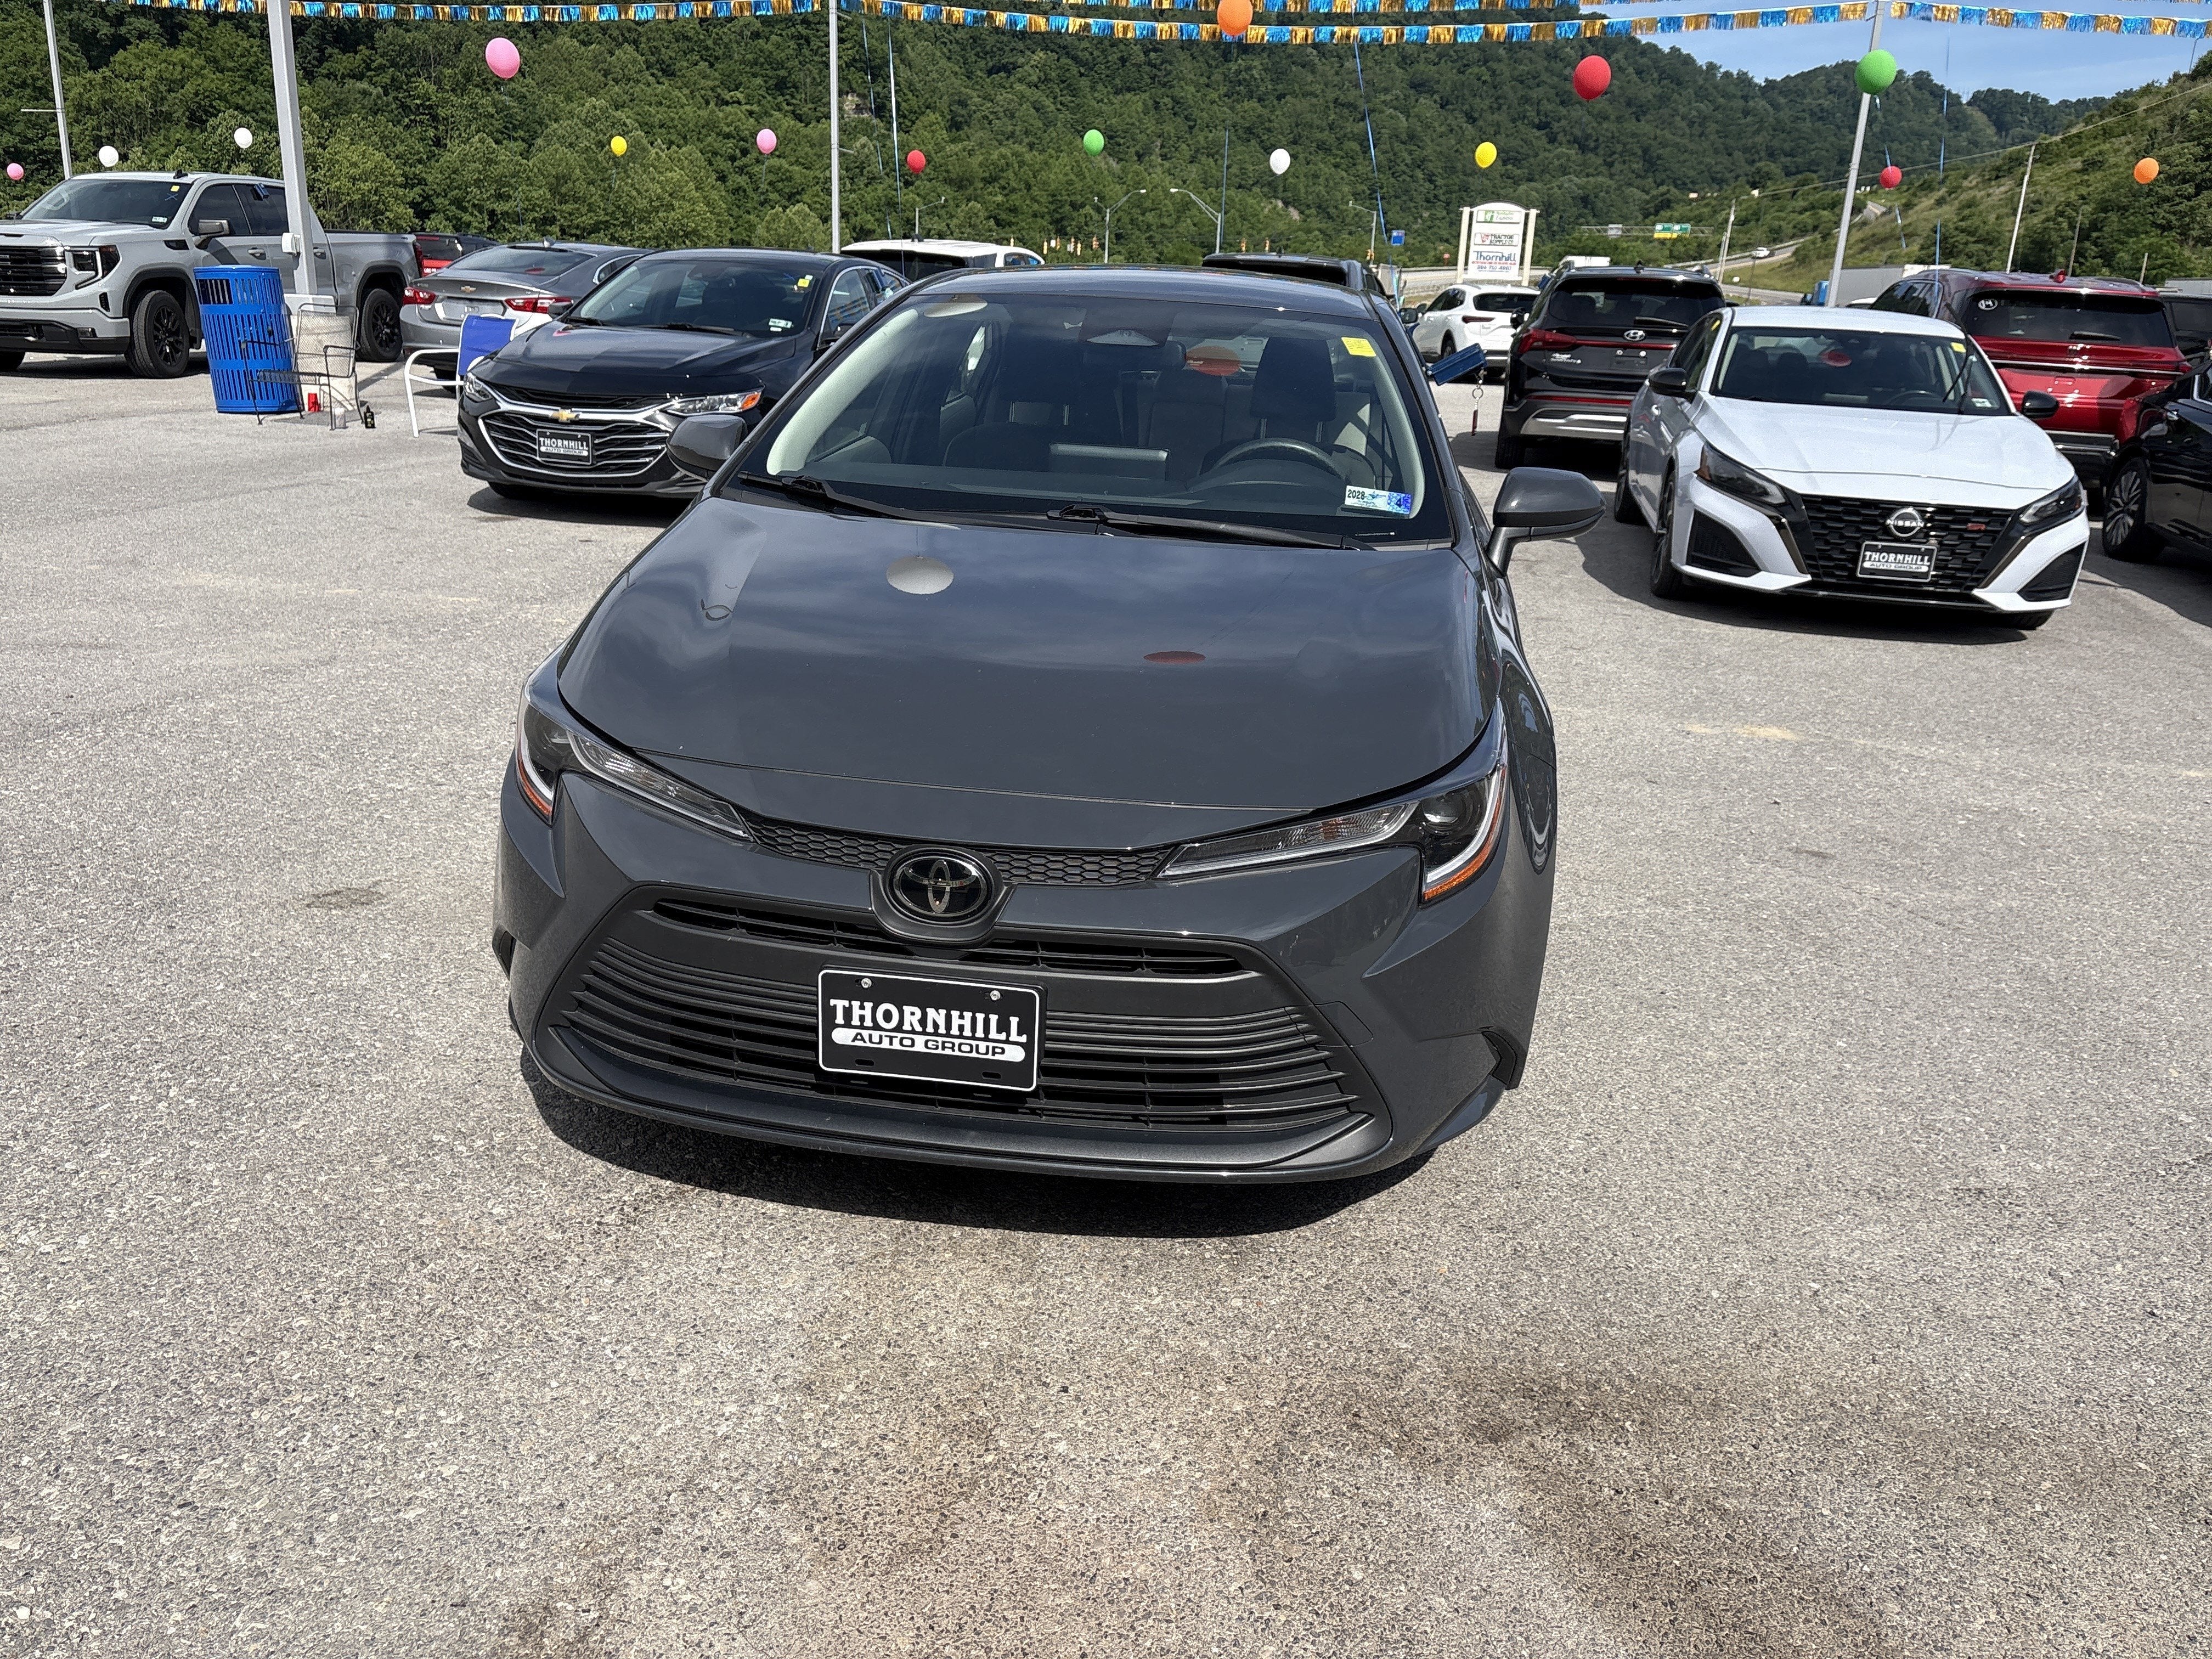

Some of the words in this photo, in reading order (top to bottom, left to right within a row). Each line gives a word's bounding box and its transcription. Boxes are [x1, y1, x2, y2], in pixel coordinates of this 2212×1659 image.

[1473, 251, 1516, 262] Thornhill
[539, 437, 589, 450] THORNHILL
[1347, 489, 1365, 500] 2028
[1865, 551, 1931, 566] THORNHILL
[830, 998, 1028, 1043] THORNHILL
[851, 1031, 915, 1048] AUTO
[924, 1039, 1006, 1057] GROUP
